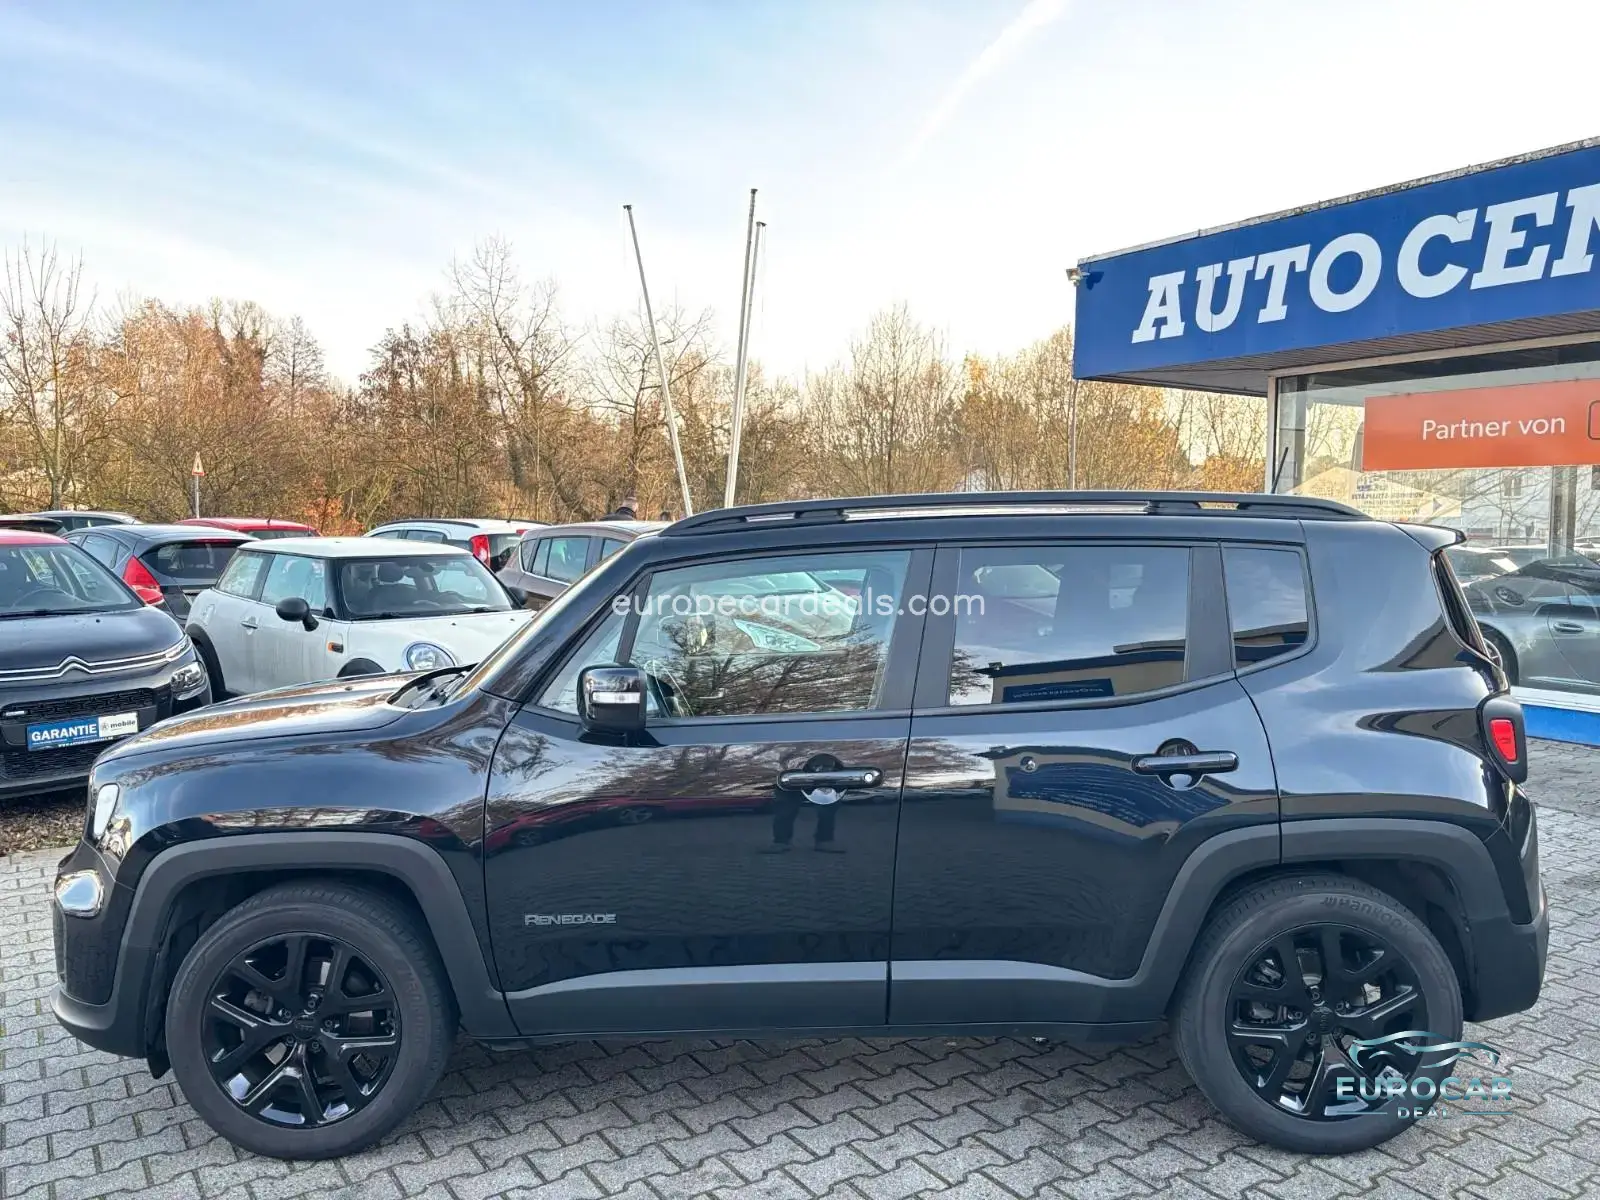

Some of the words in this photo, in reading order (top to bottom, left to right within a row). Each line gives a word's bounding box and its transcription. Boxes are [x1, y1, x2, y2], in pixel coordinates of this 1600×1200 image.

[1132, 232, 1383, 343] AUTO
[1422, 417, 1512, 441] Partner
[1518, 416, 1566, 435] von
[31, 723, 97, 742] GARANTIE
[110, 719, 136, 729] mobile
[524, 913, 617, 926] RENEGADE
